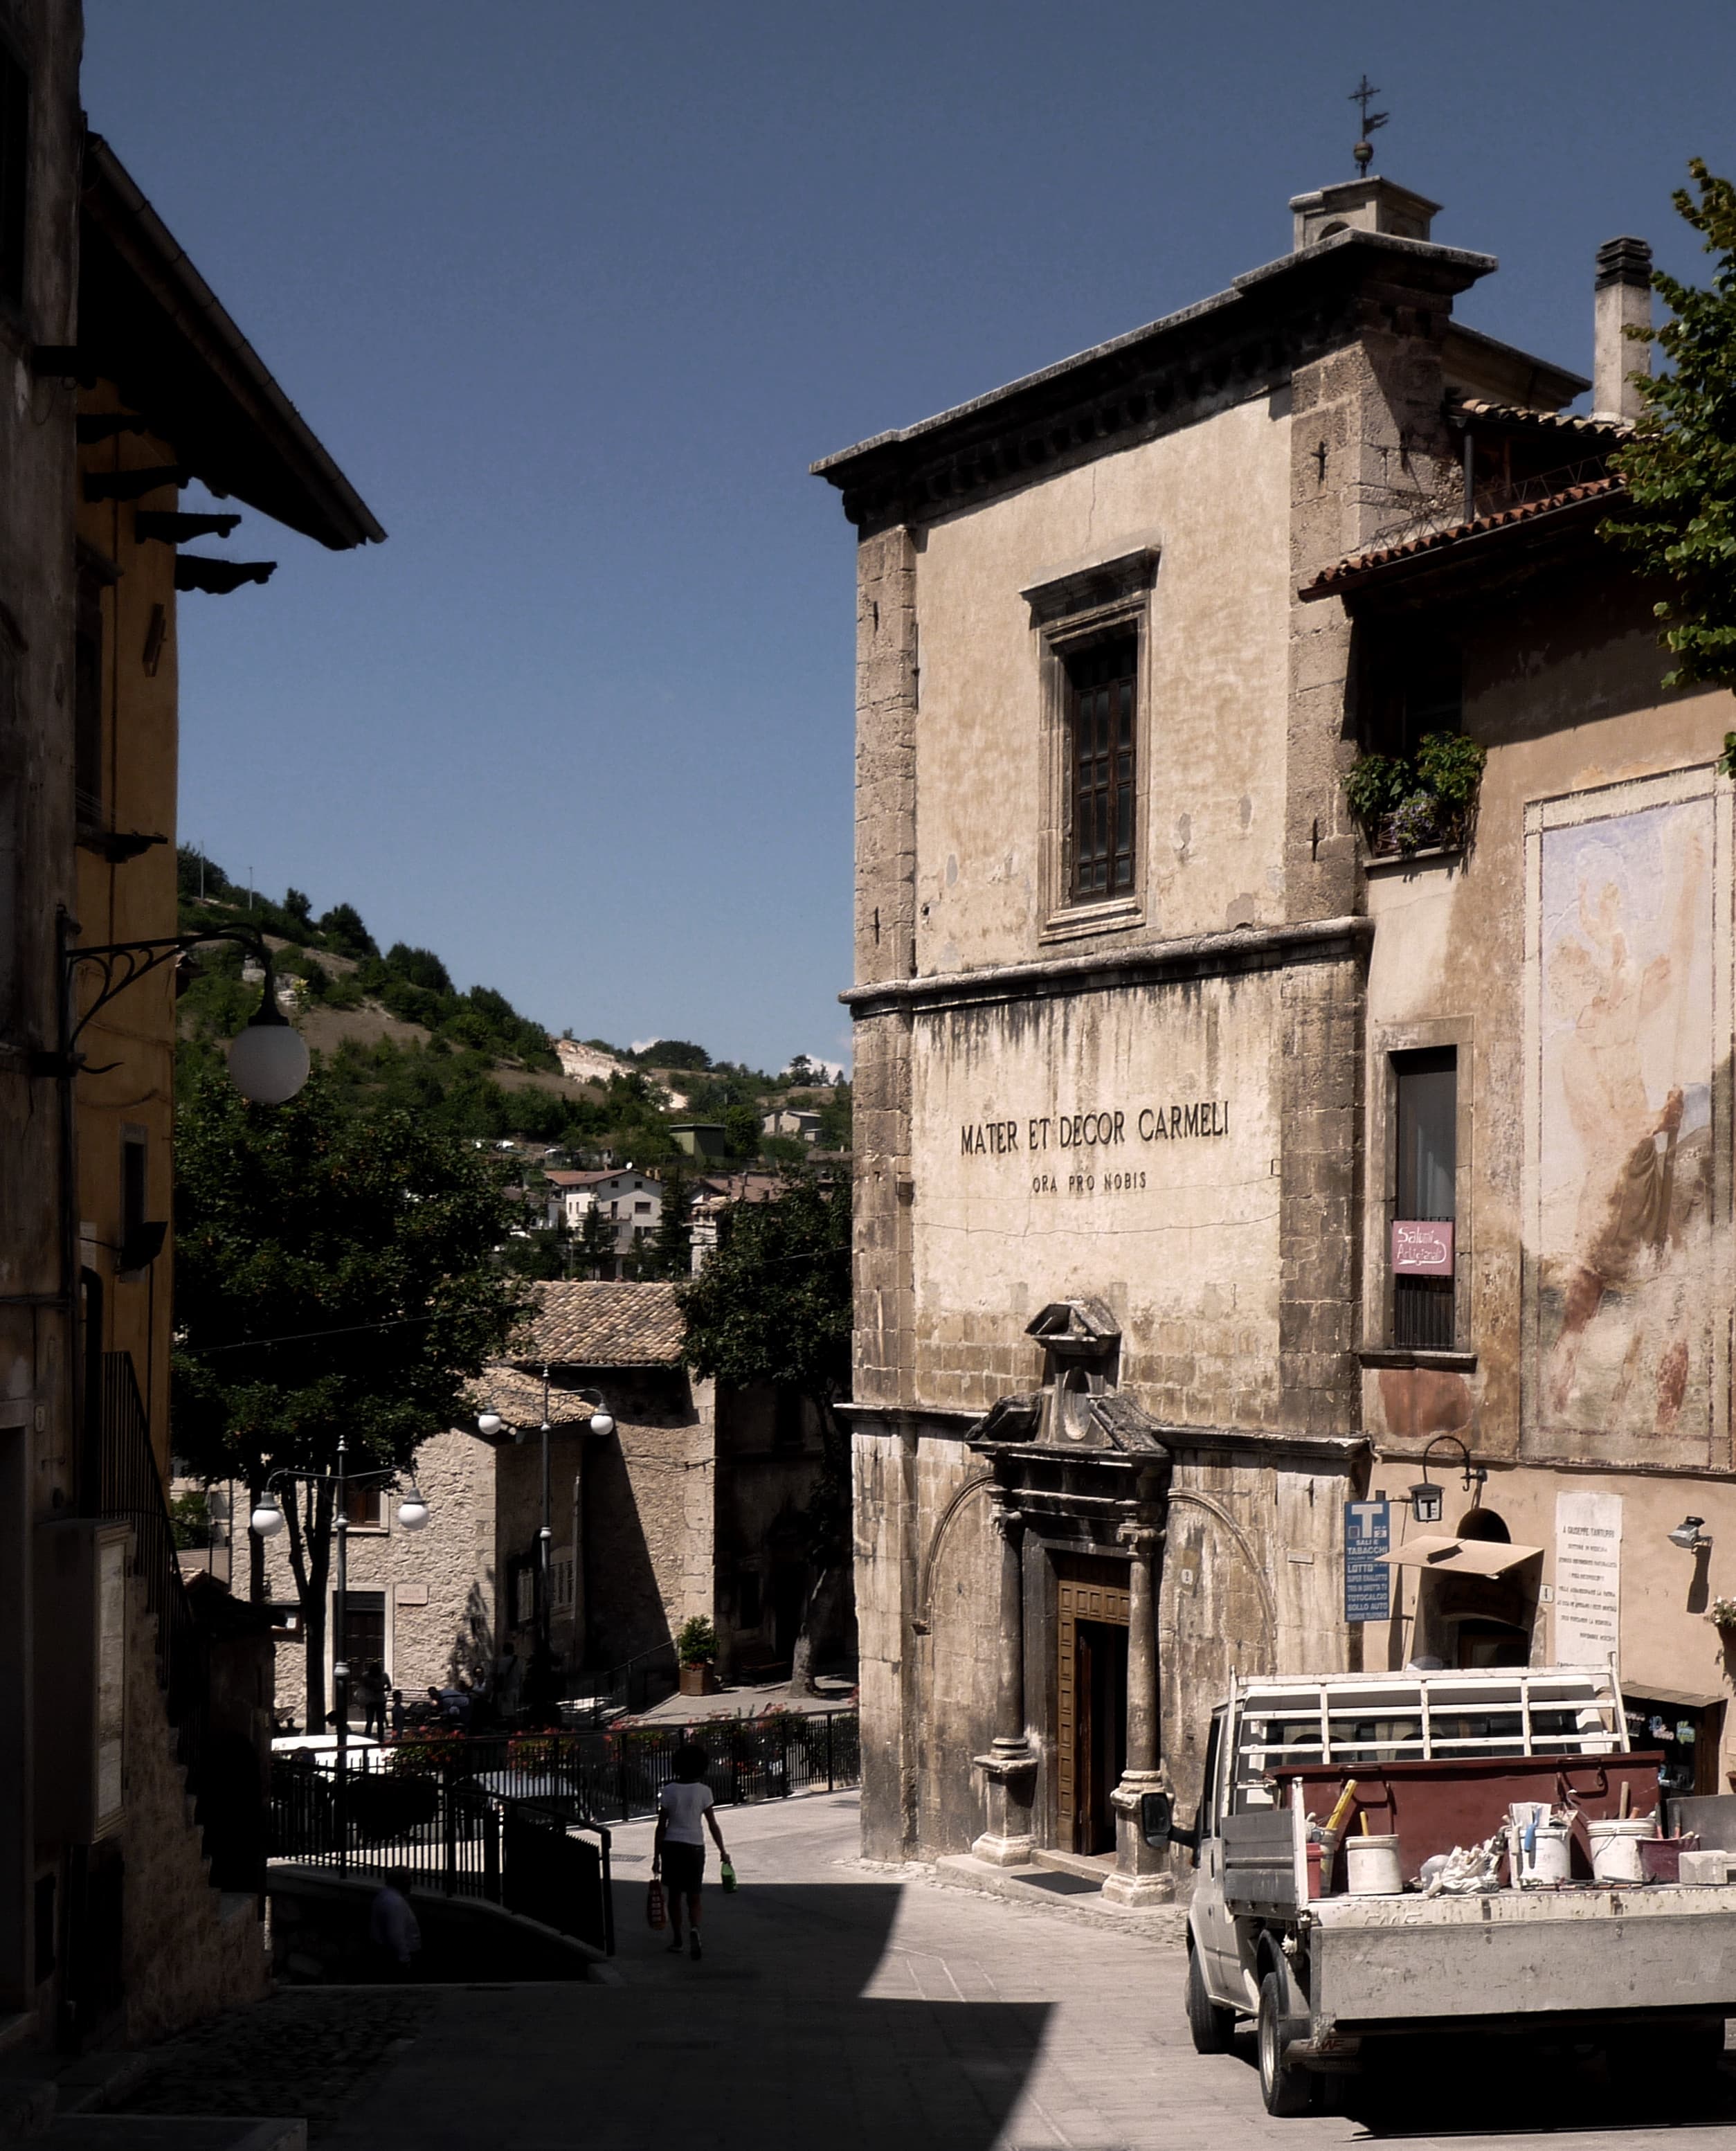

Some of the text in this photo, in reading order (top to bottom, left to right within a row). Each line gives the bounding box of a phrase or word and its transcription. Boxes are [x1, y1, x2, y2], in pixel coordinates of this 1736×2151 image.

[960, 1101, 1229, 1155] MATER ET DECOR CARMELI
[1032, 1171, 1147, 1193] ORA PRO NOBIS
[1397, 1226, 1435, 1244] Salumi
[1421, 1499, 1437, 1518] T
[1351, 1504, 1383, 1538] T
[1567, 1527, 1589, 1537] GIUSEPPE
[1347, 1546, 1389, 1555] TABACCHI
[1348, 1564, 1373, 1574] LOTTO
[1347, 1593, 1388, 1602] TOTOCALCIO
[1347, 1602, 1388, 1612] BOLLO AUTO
